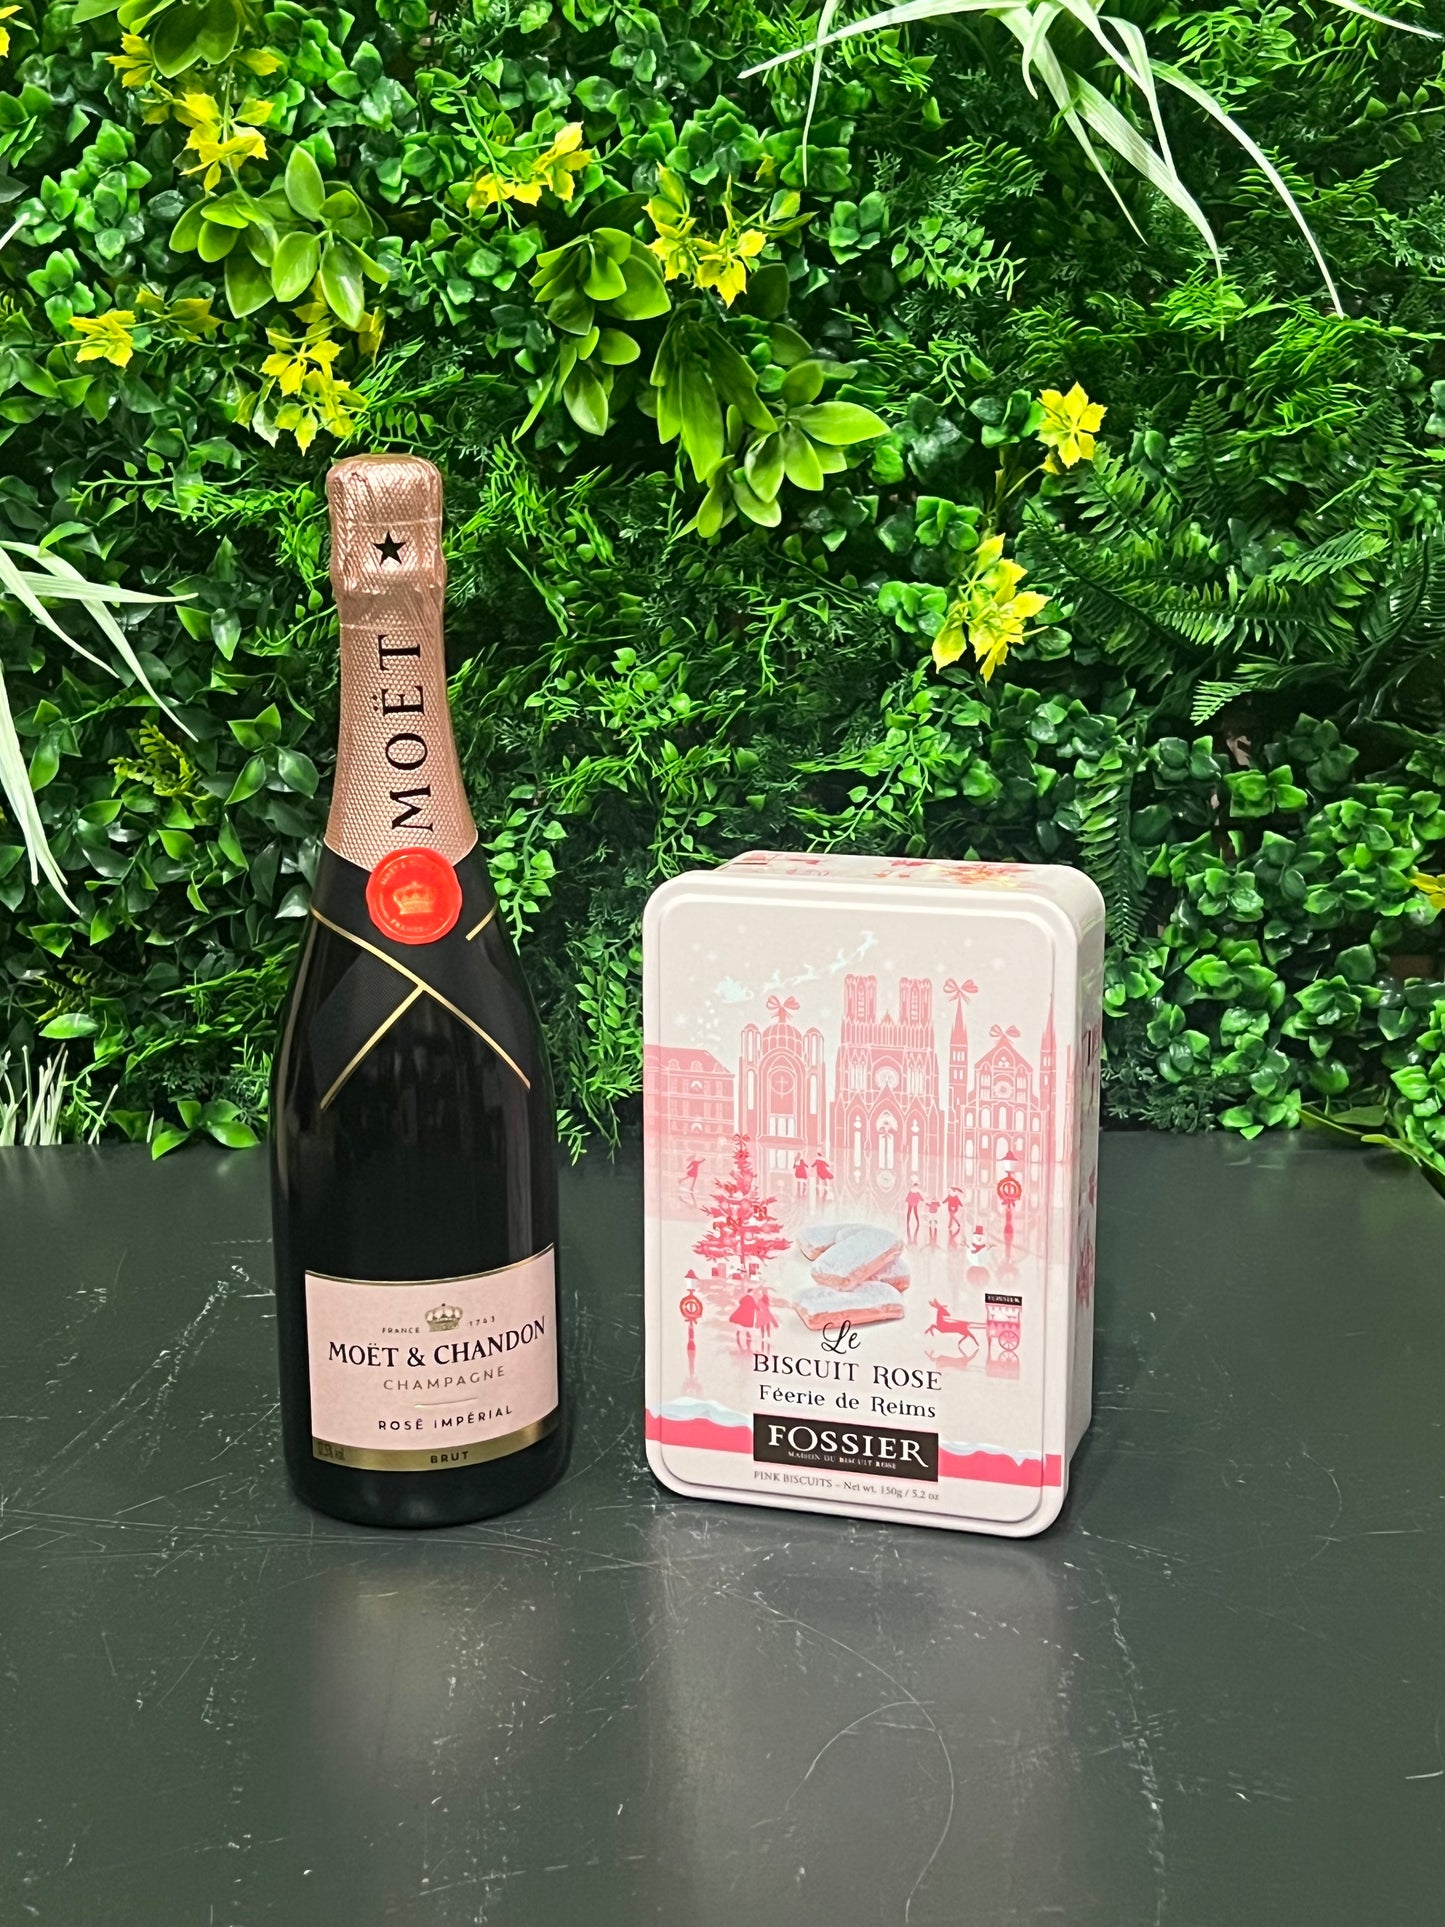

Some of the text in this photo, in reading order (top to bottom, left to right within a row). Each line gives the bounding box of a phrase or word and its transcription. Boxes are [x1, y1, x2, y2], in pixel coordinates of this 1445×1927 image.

[371, 634, 434, 833] MOËT
[328, 1315, 545, 1367] MOËT & CHANDON
[820, 1319, 861, 1354] Le
[383, 1365, 505, 1390] CHAMPAGNE
[753, 1353, 942, 1390] BISCUIT ROSE
[434, 1405, 512, 1429] IMPÉRIAL
[759, 1384, 936, 1418] Féerie de Reims
[430, 1451, 469, 1463] BRUT
[767, 1424, 929, 1468] FOSSIER
[753, 1470, 781, 1483] PINK
[783, 1474, 833, 1488] BISCUITS
[843, 1481, 860, 1491] Net
[880, 1485, 903, 1499] 150g
[912, 1489, 926, 1499] 5.2
[928, 1493, 940, 1501] oz
